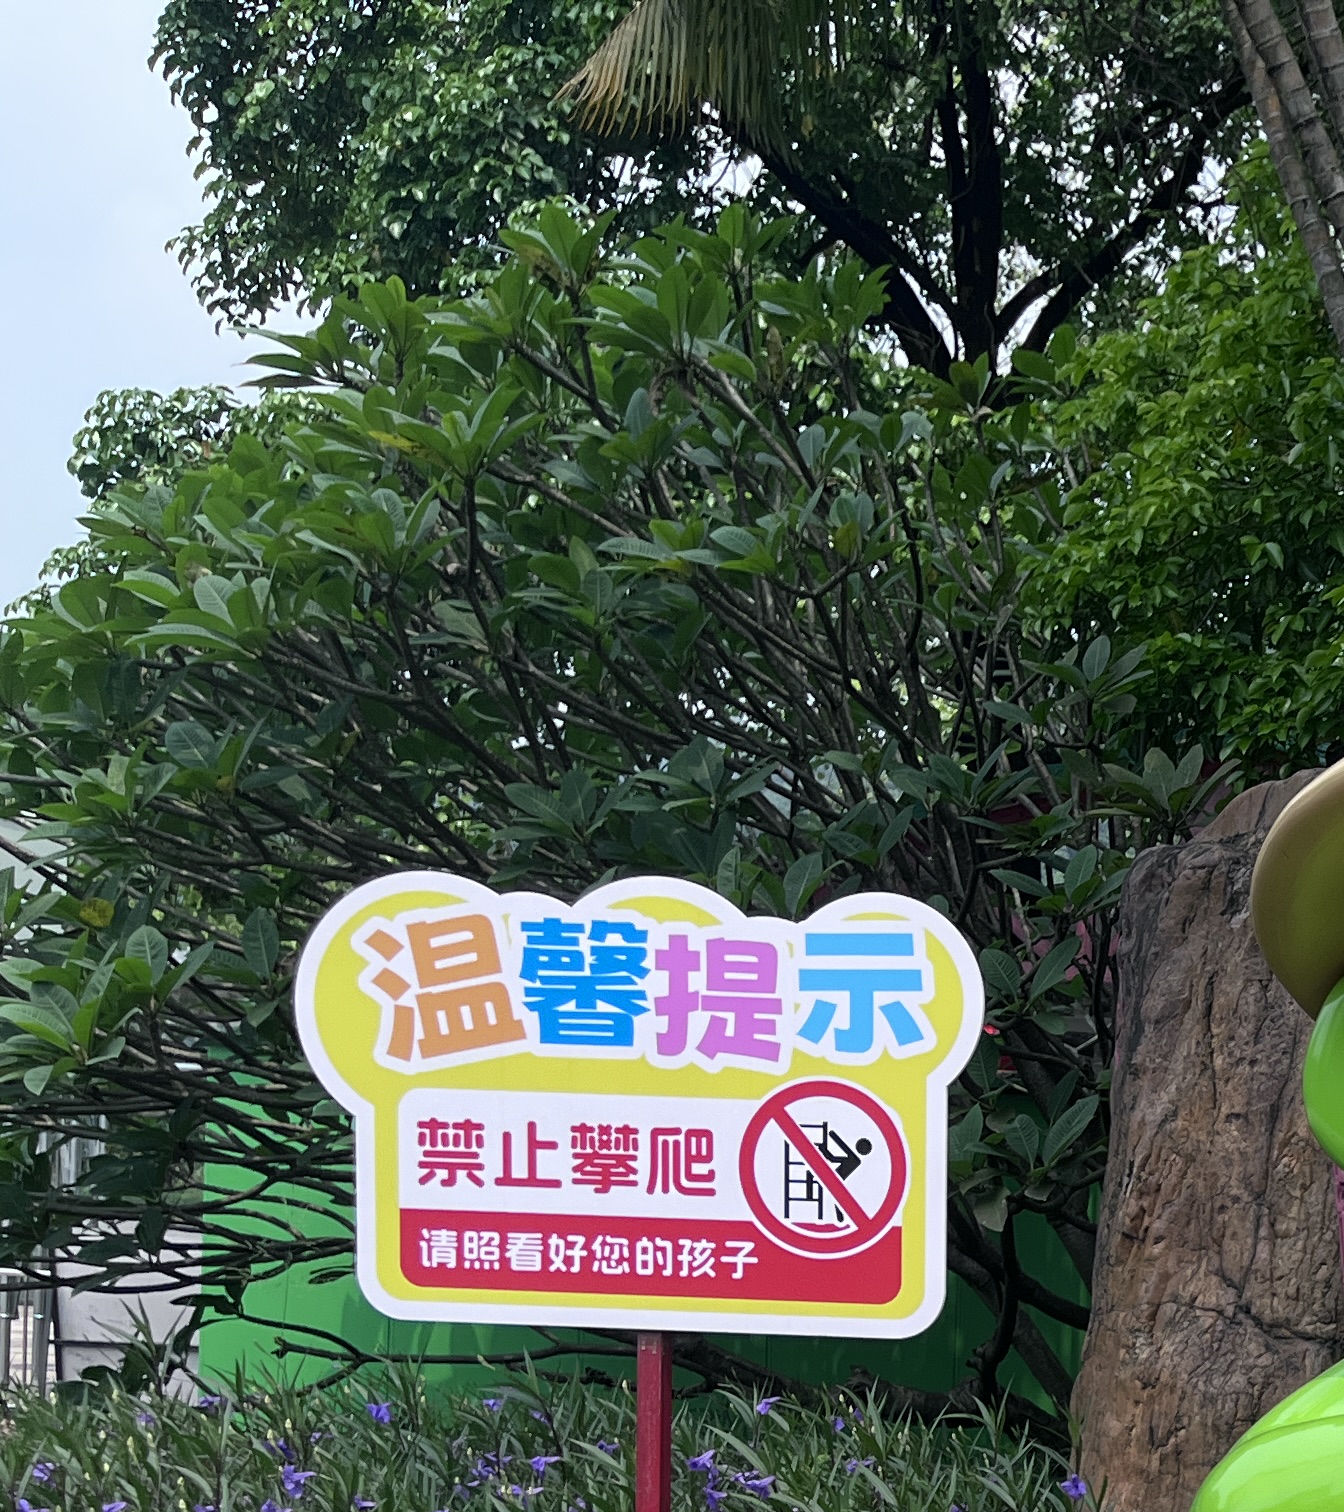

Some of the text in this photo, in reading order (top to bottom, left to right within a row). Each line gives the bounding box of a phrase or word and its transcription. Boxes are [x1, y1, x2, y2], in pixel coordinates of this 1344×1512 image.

[363, 912, 926, 1064] 温馨提示
[416, 1116, 717, 1197] 禁止攀爬
[418, 1228, 760, 1281] 请照看好您的孩子
